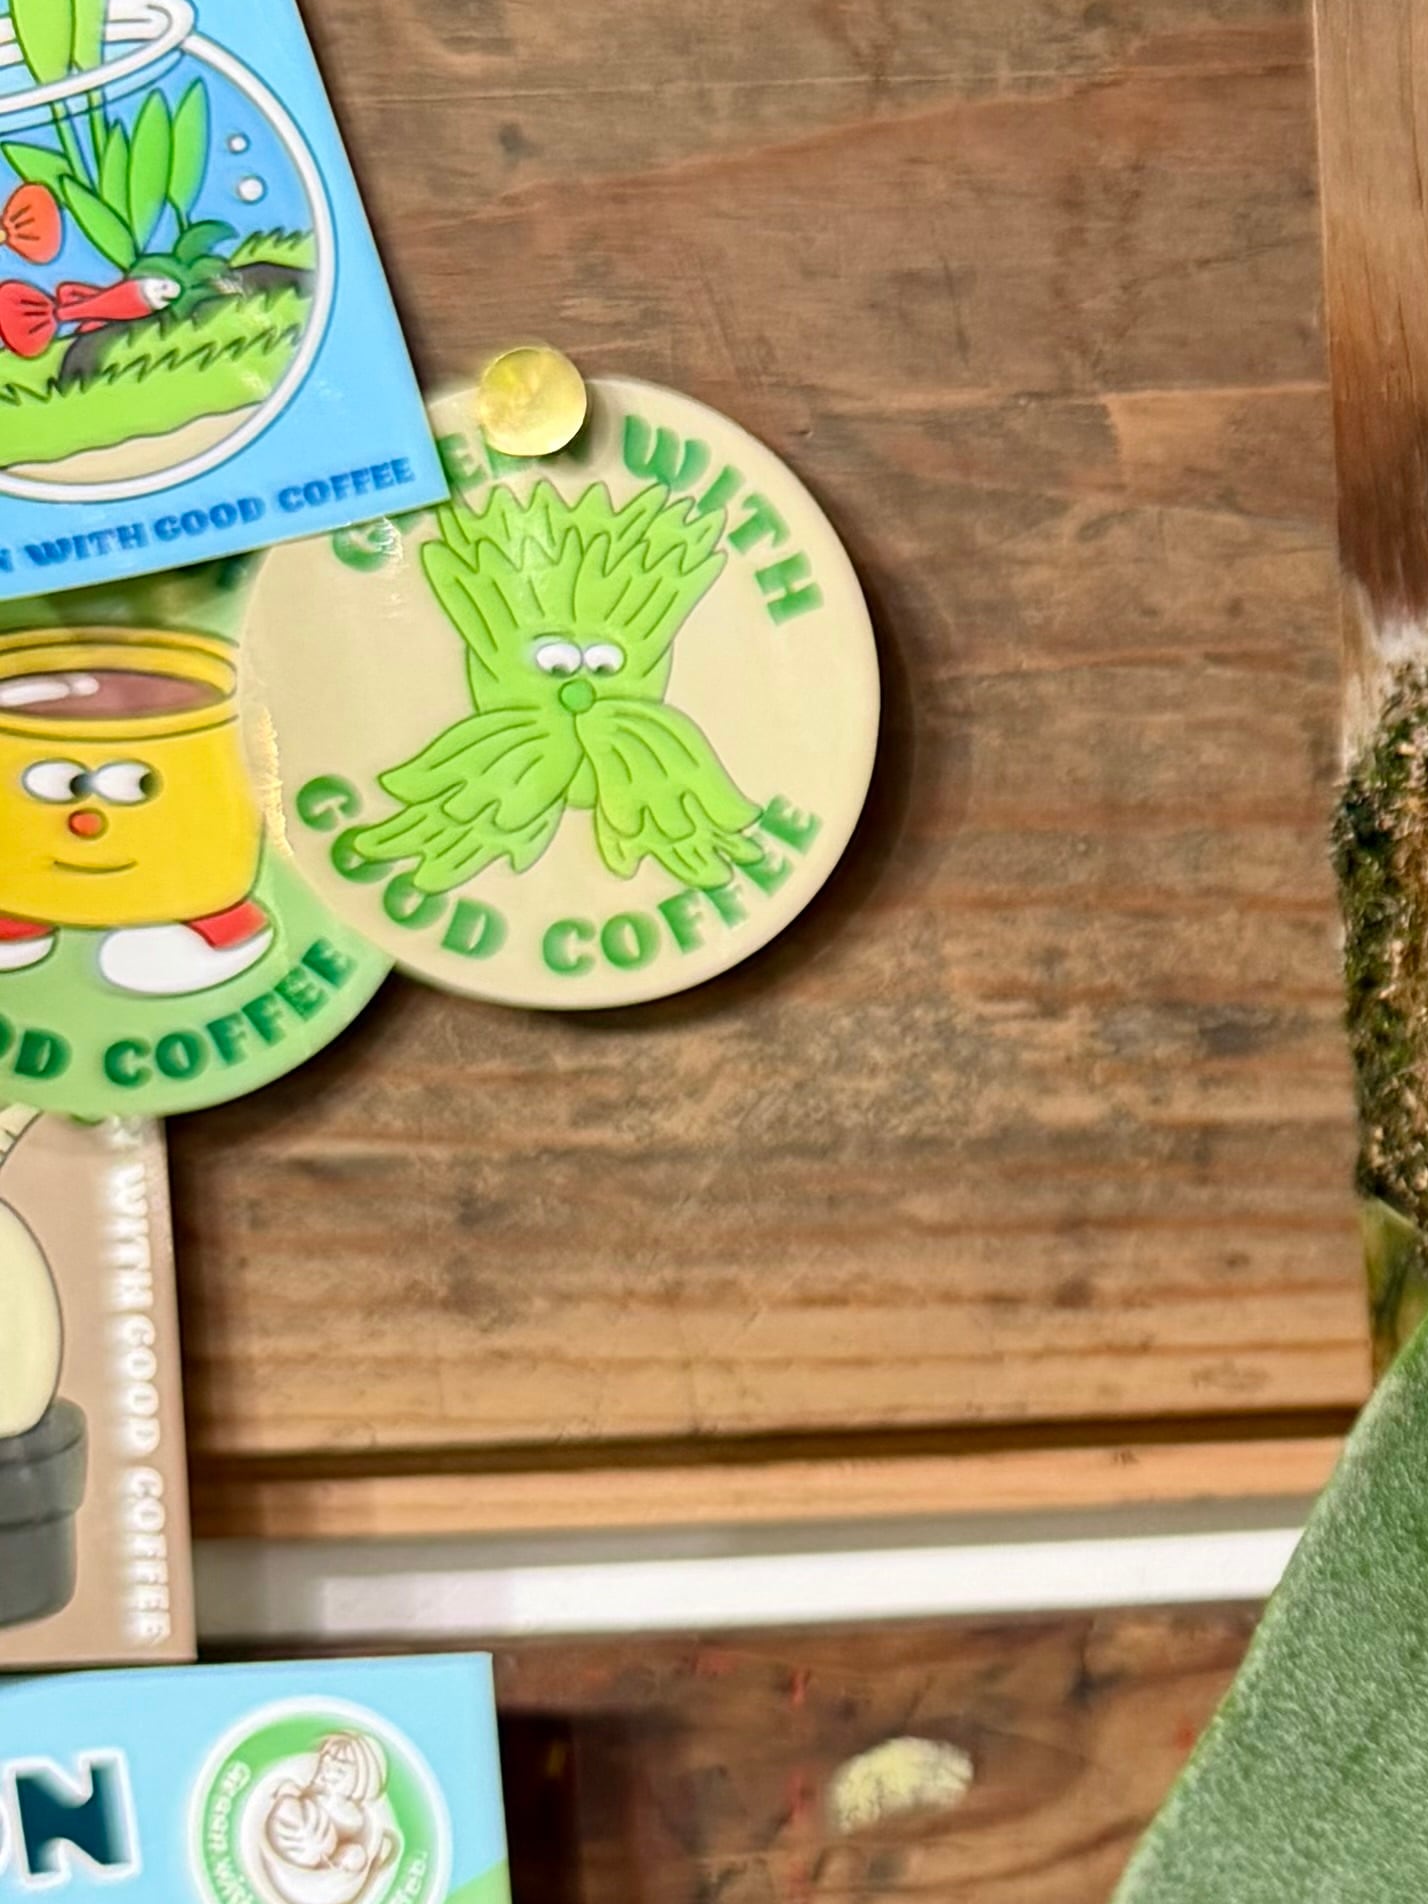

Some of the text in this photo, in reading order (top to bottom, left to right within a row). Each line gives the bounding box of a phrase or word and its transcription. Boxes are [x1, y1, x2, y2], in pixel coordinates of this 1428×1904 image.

[24, 518, 148, 567] WITH
[153, 491, 266, 543] GOOD
[277, 456, 416, 514] COFFEE
[622, 414, 822, 626] WITH
[296, 774, 824, 976] GOOD COFFEE
[104, 936, 360, 1086] COFFEE
